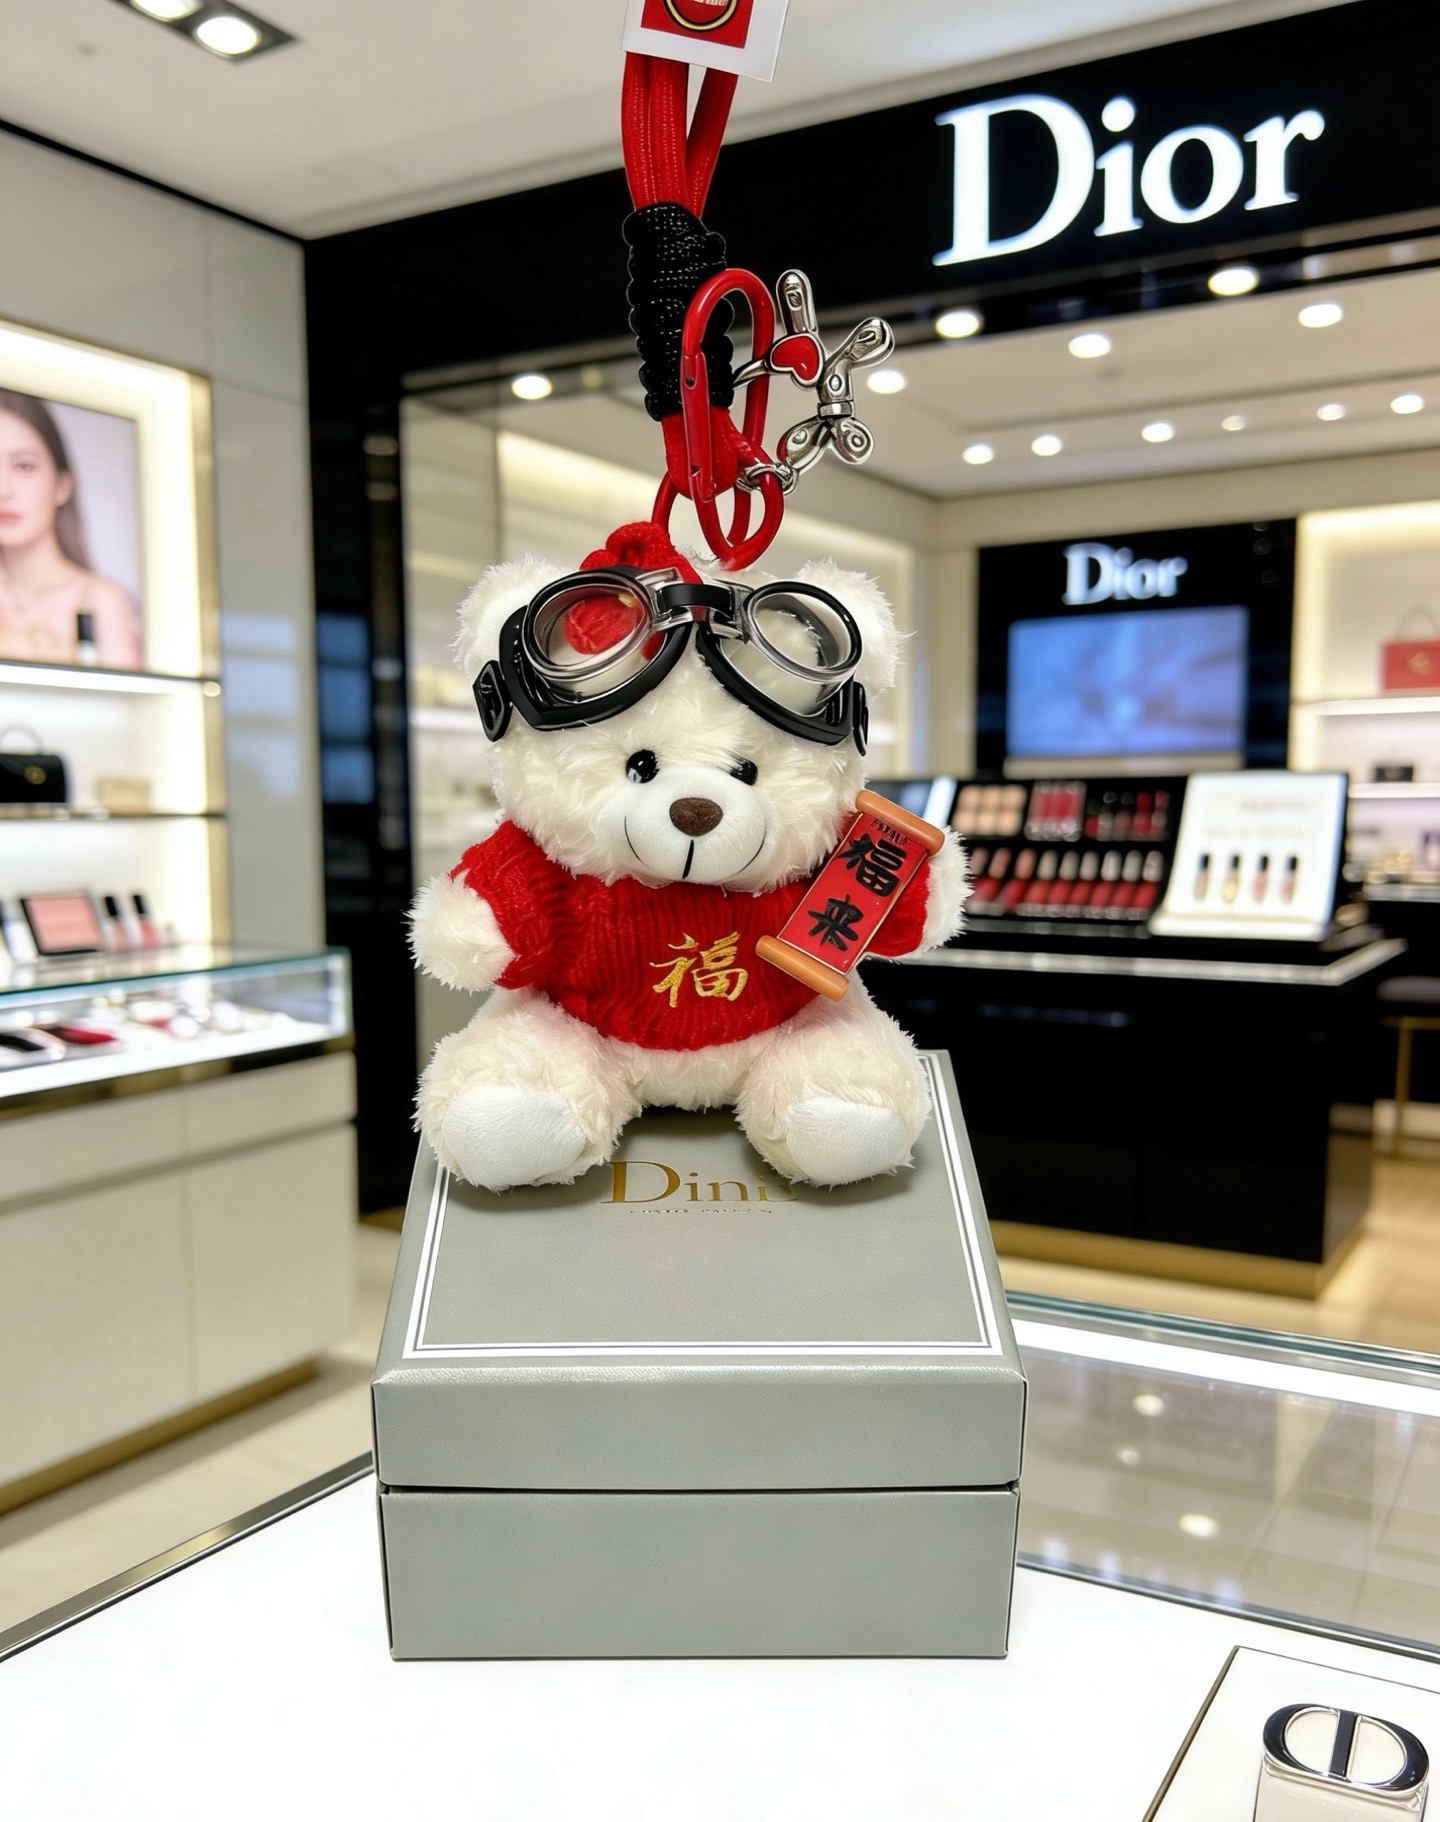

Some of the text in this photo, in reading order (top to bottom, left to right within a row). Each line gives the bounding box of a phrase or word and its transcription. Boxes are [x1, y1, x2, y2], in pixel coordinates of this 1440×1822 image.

[932, 94, 1325, 266] Dior
[1062, 542, 1188, 605] Dior
[649, 931, 749, 1008] 福
